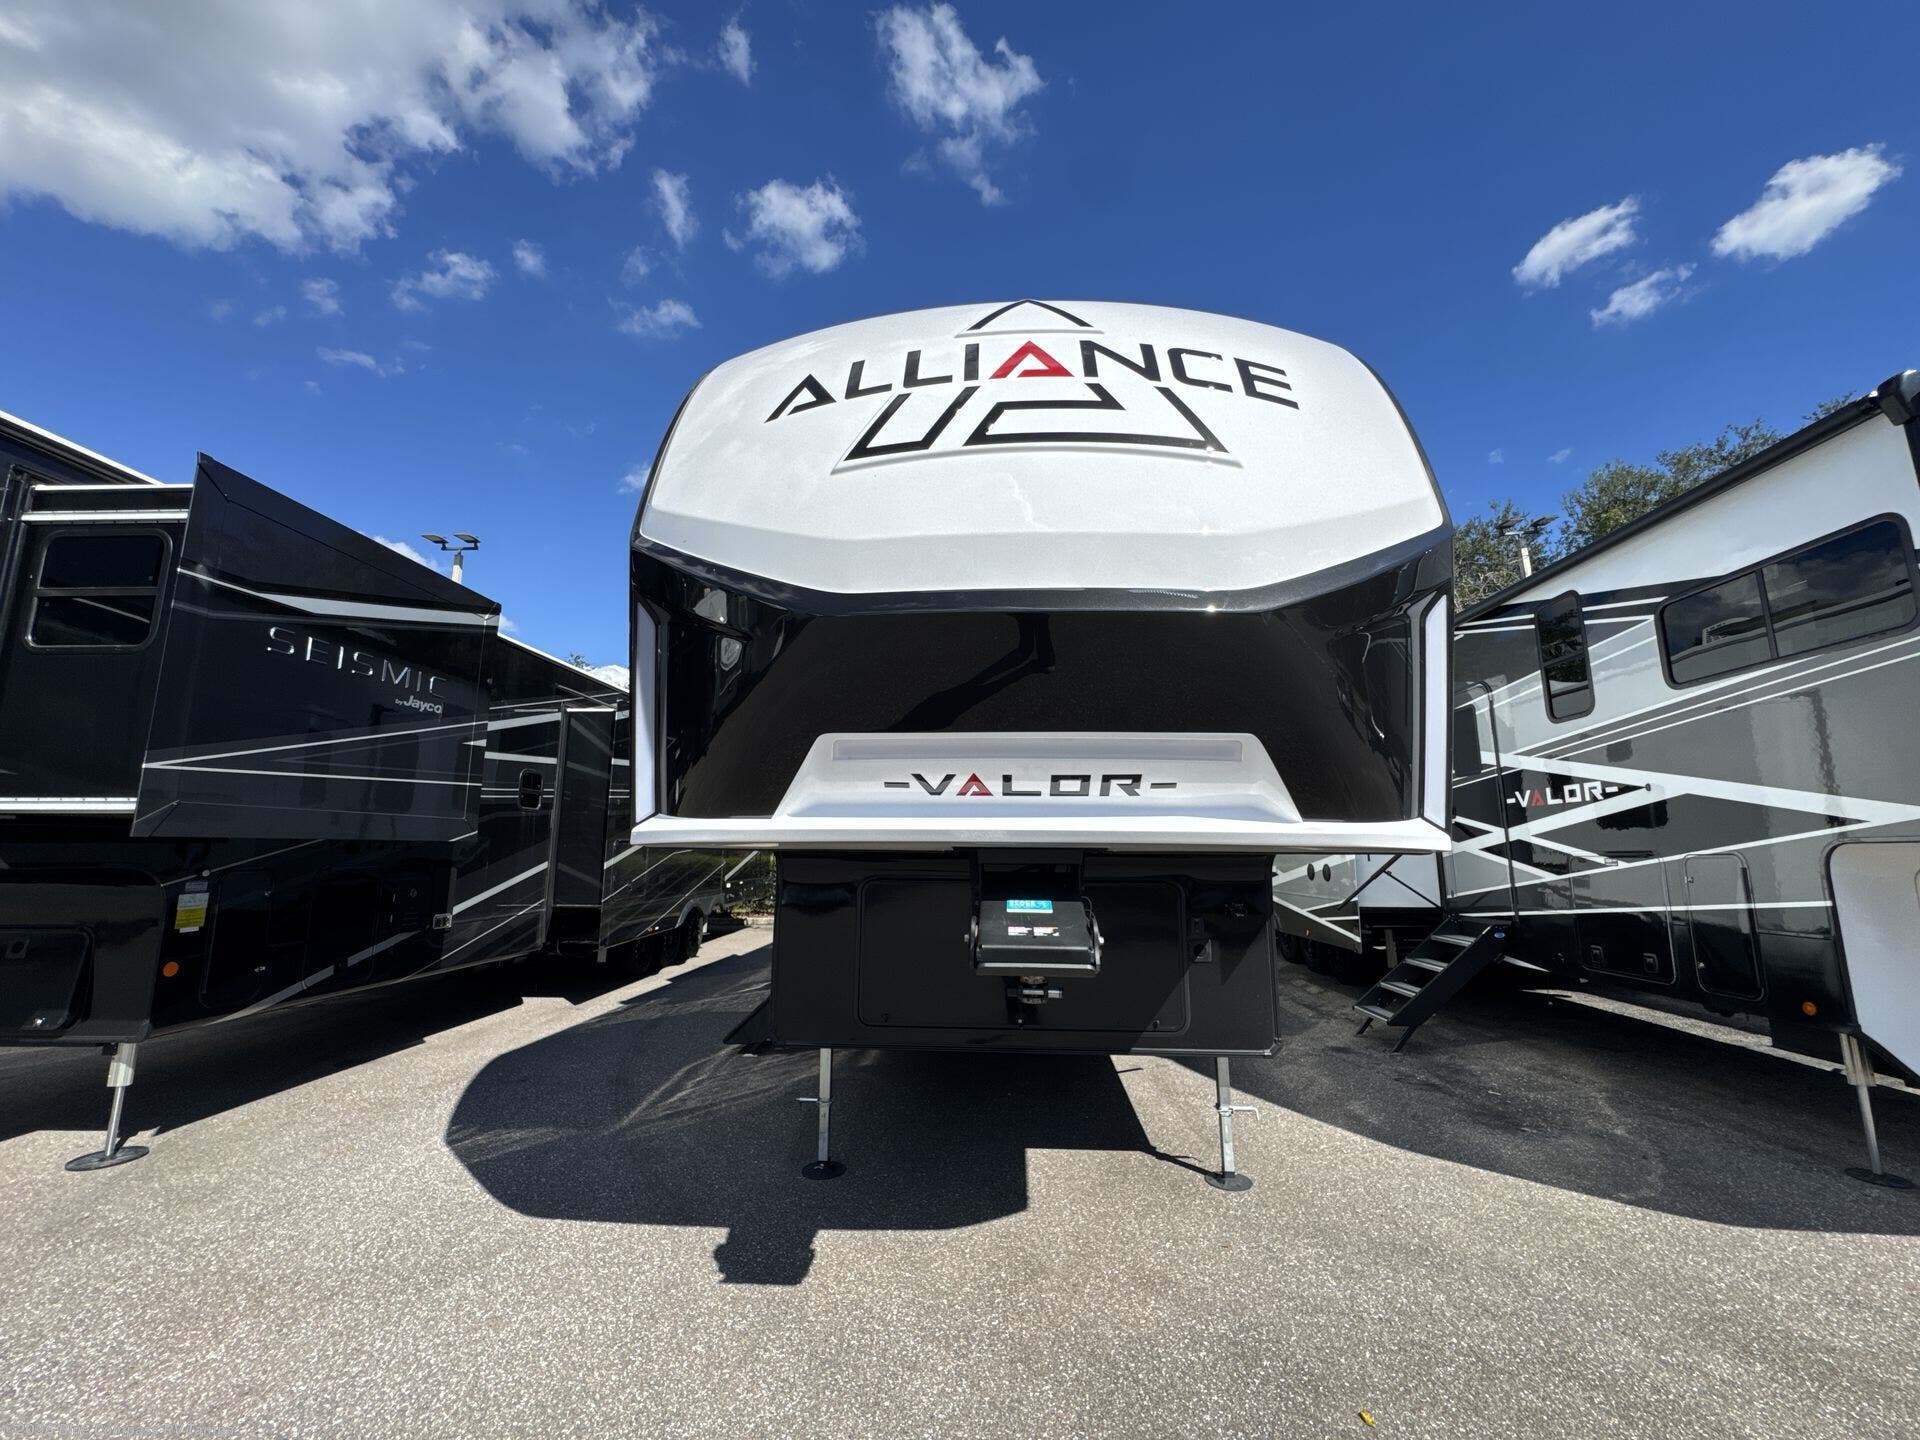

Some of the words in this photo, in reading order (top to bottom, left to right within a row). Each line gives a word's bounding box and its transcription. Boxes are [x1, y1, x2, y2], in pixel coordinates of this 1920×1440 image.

[764, 340, 1299, 423] ALLIANCE
[267, 626, 447, 699] SEISMIC
[404, 695, 443, 714] Jayco
